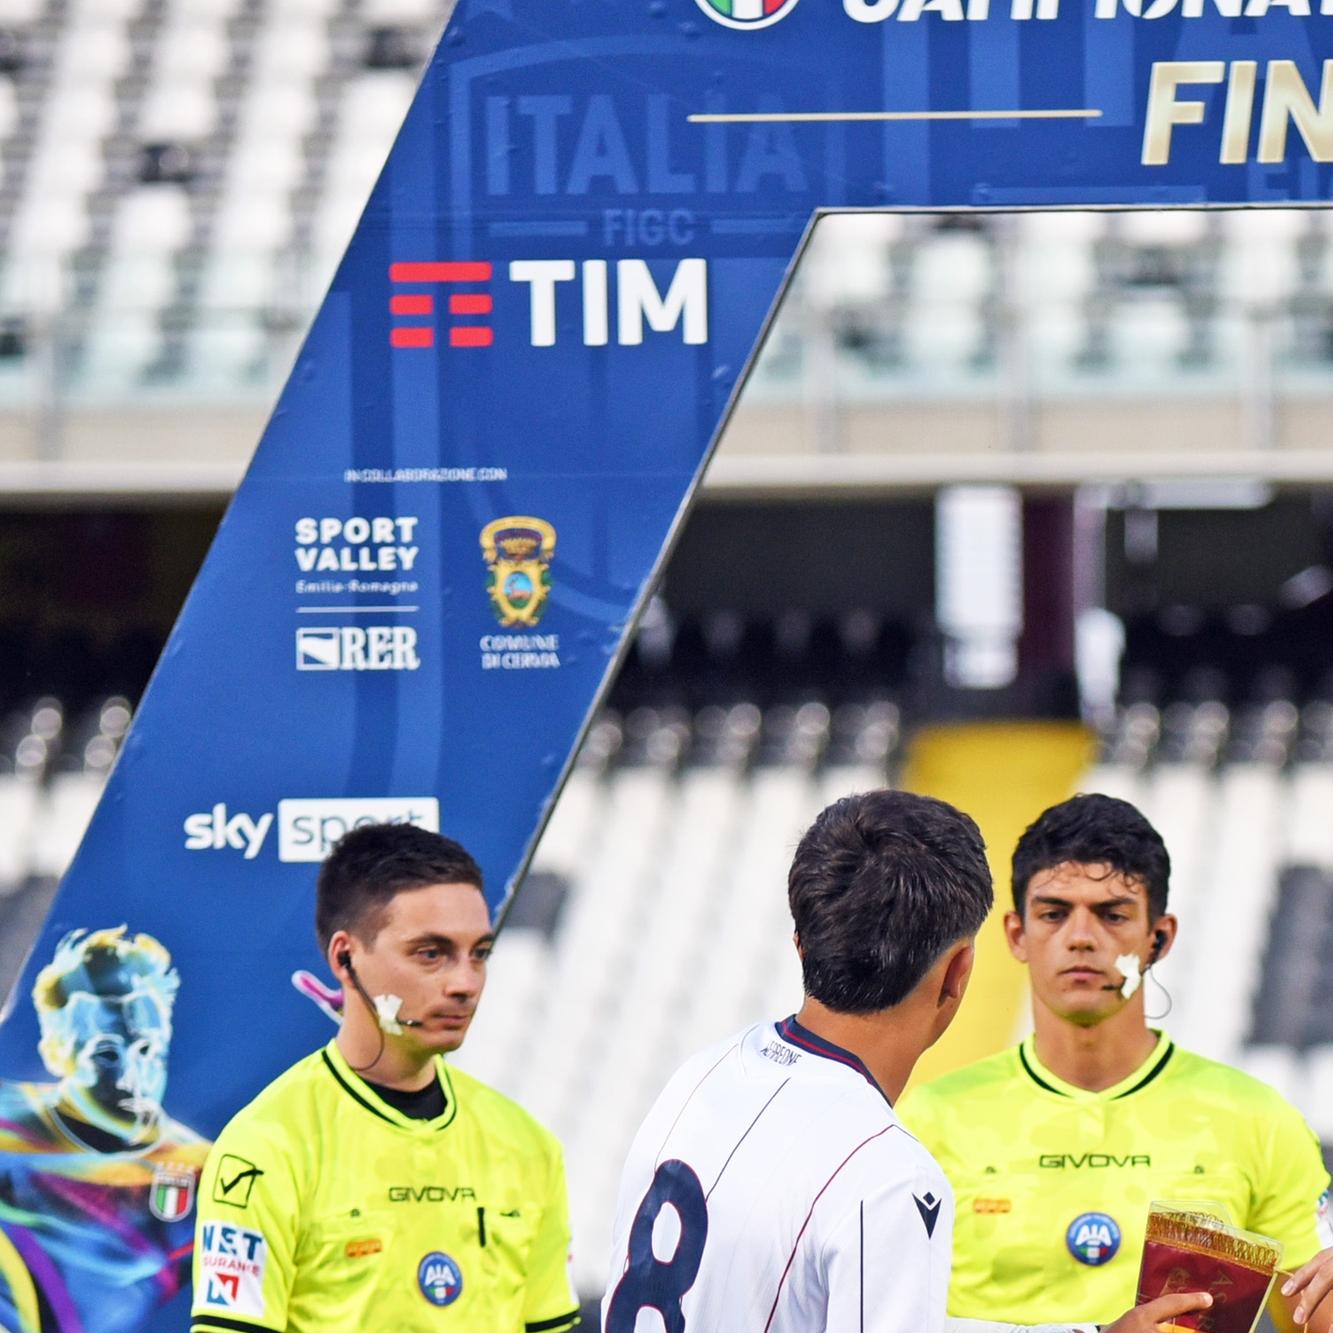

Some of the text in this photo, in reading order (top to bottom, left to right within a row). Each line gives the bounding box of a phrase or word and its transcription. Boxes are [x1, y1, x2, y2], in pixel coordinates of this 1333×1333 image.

[486, 95, 809, 194] ITALIA
[602, 209, 695, 246] FIGC
[509, 258, 708, 347] TIM
[295, 517, 418, 544] SPORT
[294, 547, 419, 571] VALLEY
[183, 802, 273, 859] sky
[1039, 1153, 1151, 1168] GIVOVA
[388, 1186, 476, 1202] GIVOVA
[1075, 1224, 1112, 1247] AIA
